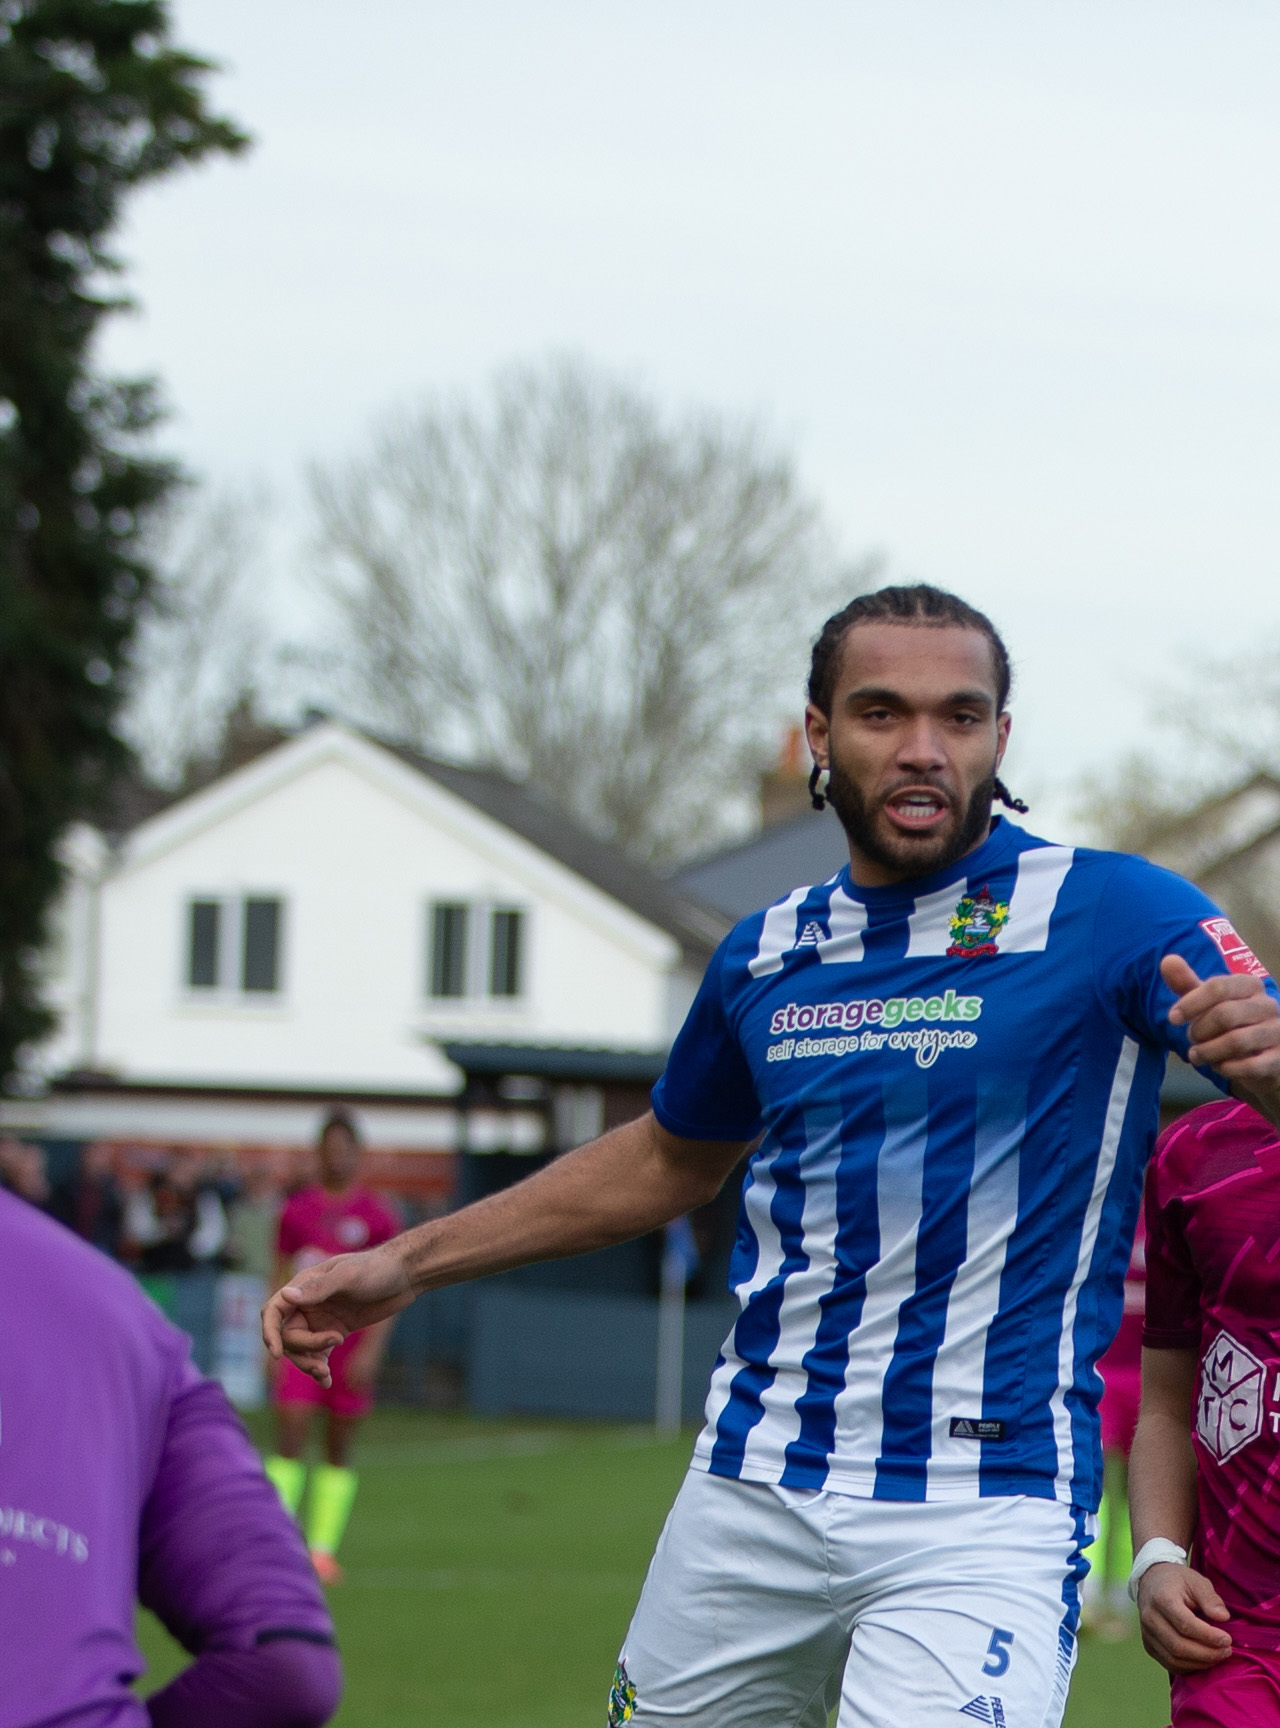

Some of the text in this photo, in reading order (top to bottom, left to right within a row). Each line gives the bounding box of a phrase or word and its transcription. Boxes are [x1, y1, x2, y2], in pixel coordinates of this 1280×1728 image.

[771, 991, 981, 1033] storagegeeks
[768, 1030, 977, 1067] self storage for everyone
[1211, 1350, 1233, 1382] M
[981, 1627, 1014, 1677] 5
